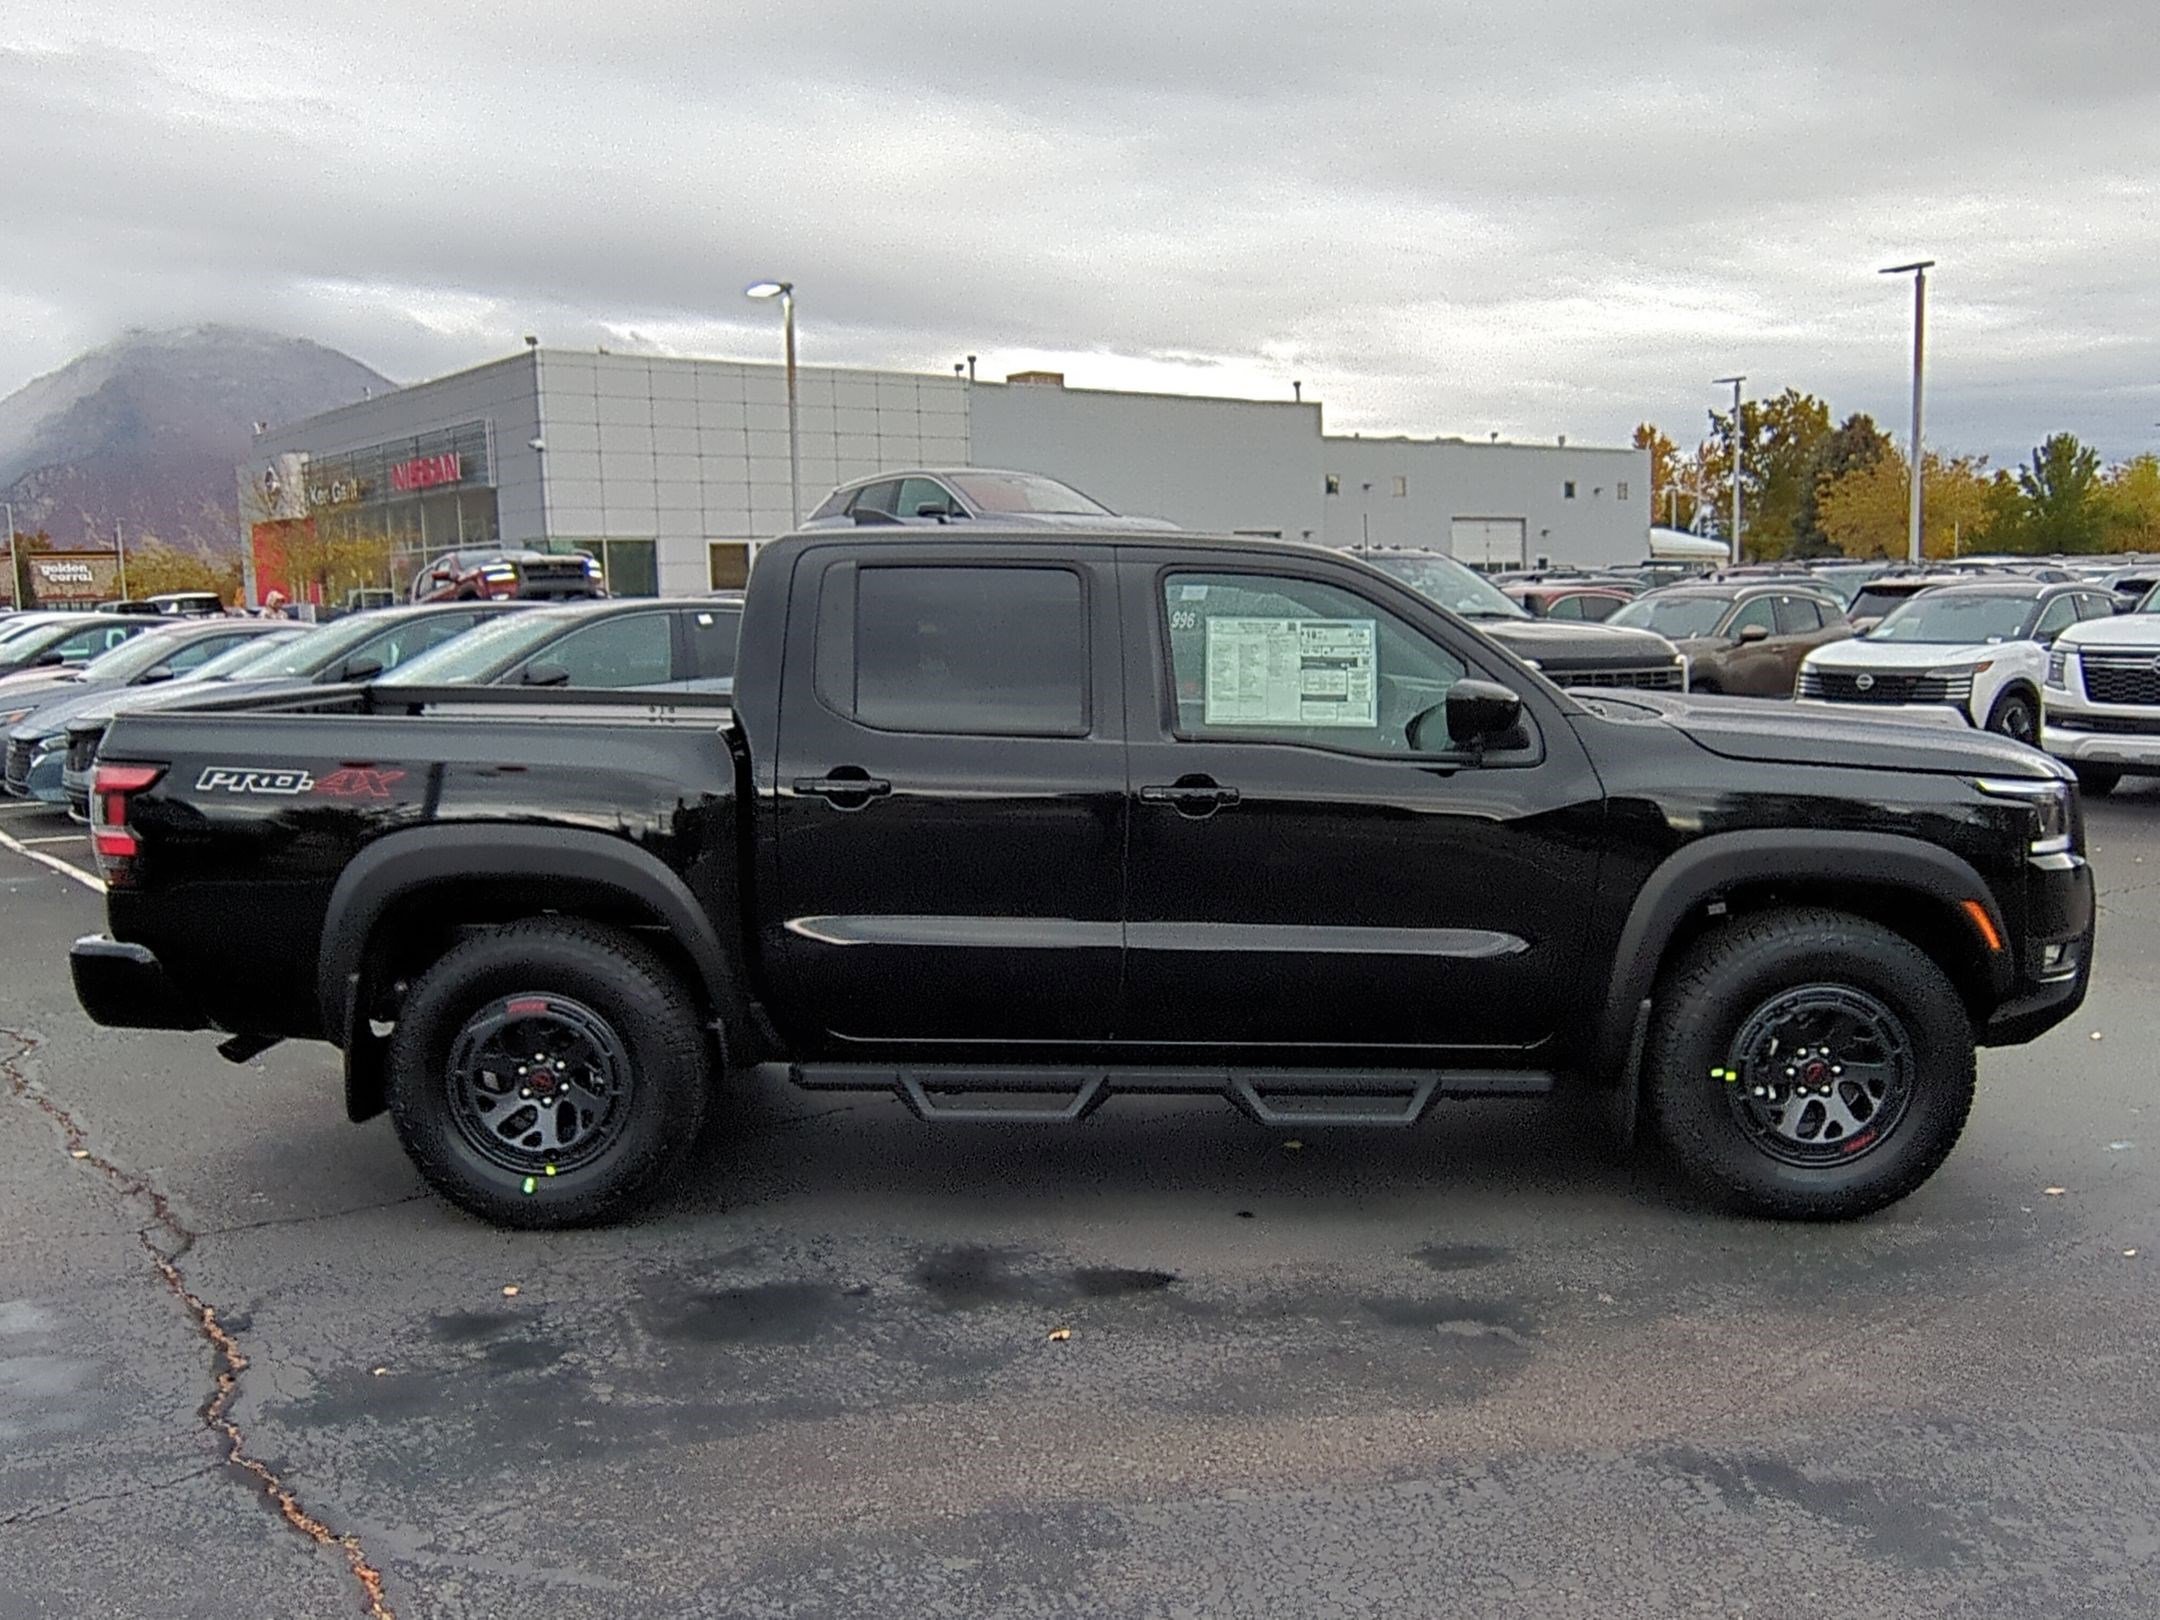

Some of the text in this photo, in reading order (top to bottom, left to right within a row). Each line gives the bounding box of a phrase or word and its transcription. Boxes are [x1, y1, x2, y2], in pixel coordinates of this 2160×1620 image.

[391, 452, 463, 491] NISSAN
[309, 483, 328, 505] Ken
[41, 563, 88, 577] golden
[49, 571, 93, 582] corral
